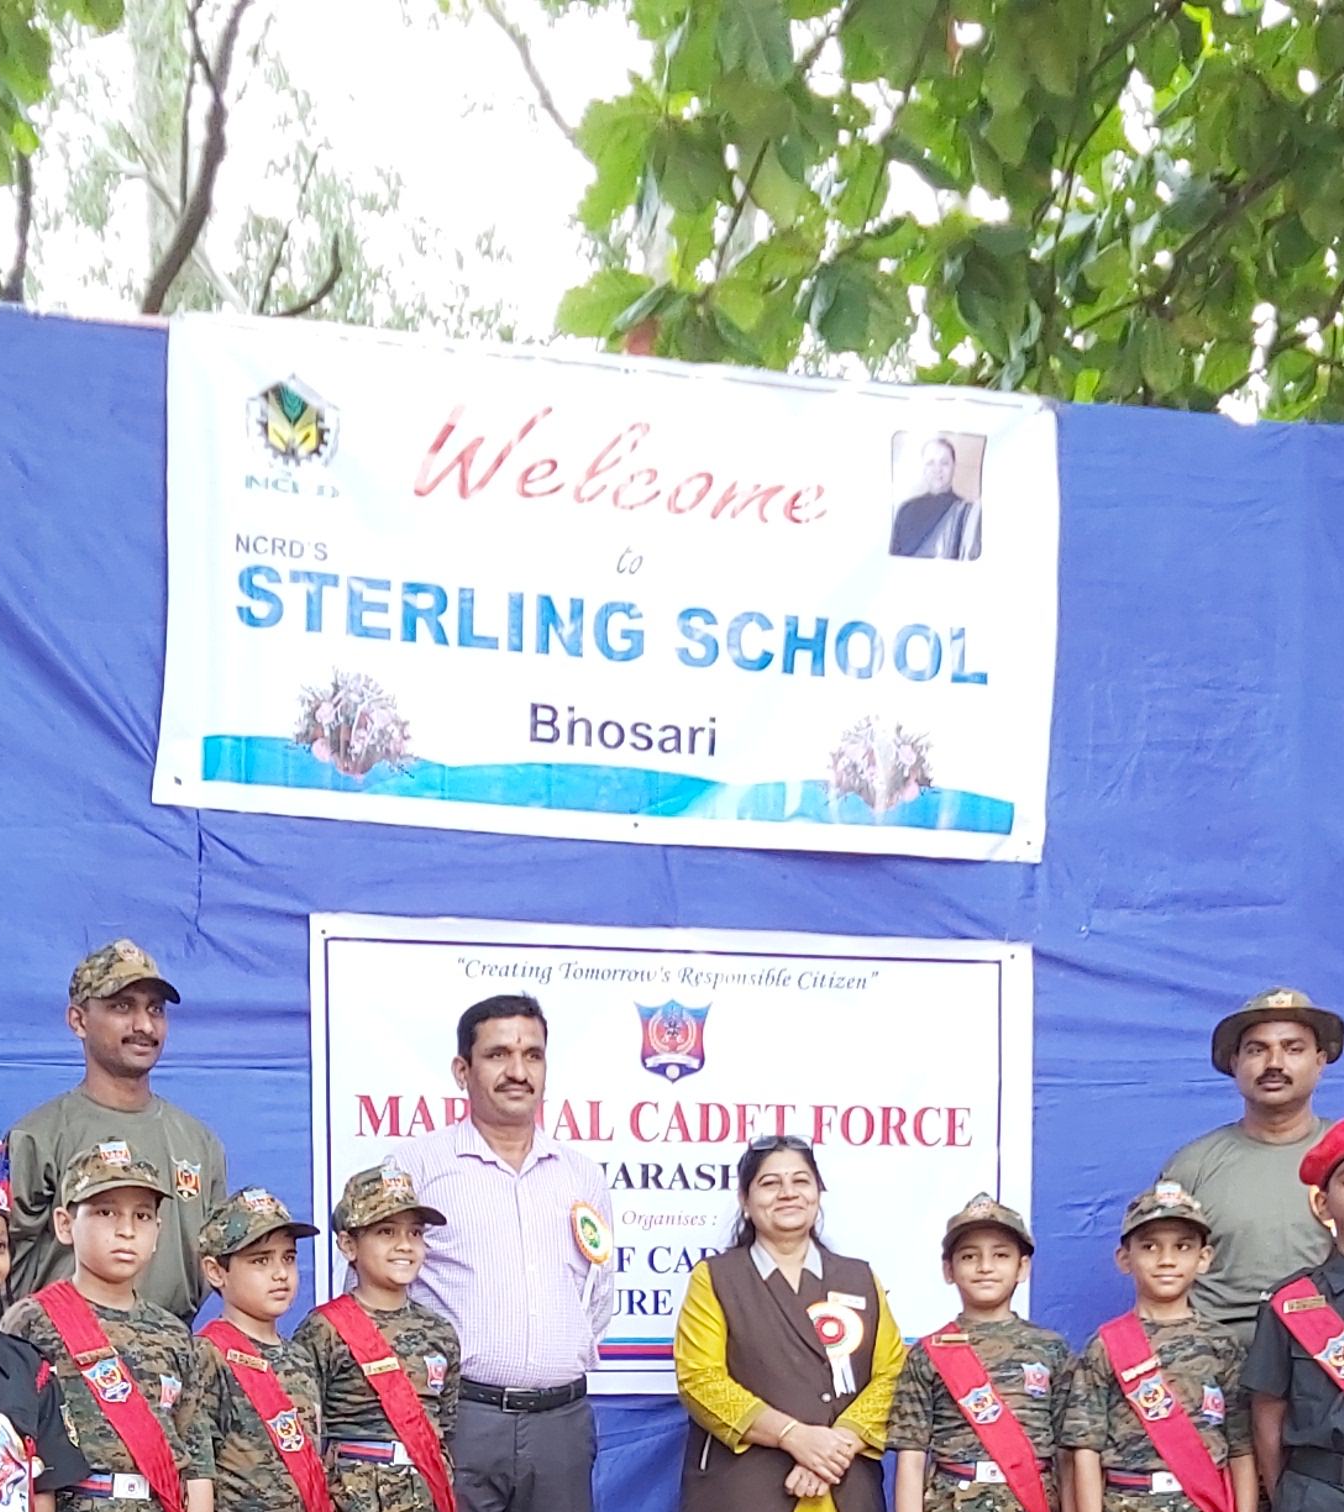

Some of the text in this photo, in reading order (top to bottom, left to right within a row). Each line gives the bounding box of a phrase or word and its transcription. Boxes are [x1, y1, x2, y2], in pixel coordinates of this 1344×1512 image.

[414, 404, 828, 525] Welcome
[616, 545, 644, 576] to
[235, 563, 990, 686] STERLING SCHOOL
[528, 702, 718, 758] Bhosari
[678, 966, 792, 991] Responsible
[808, 1103, 973, 1148] FORCE
[621, 1210, 707, 1231] Organises
